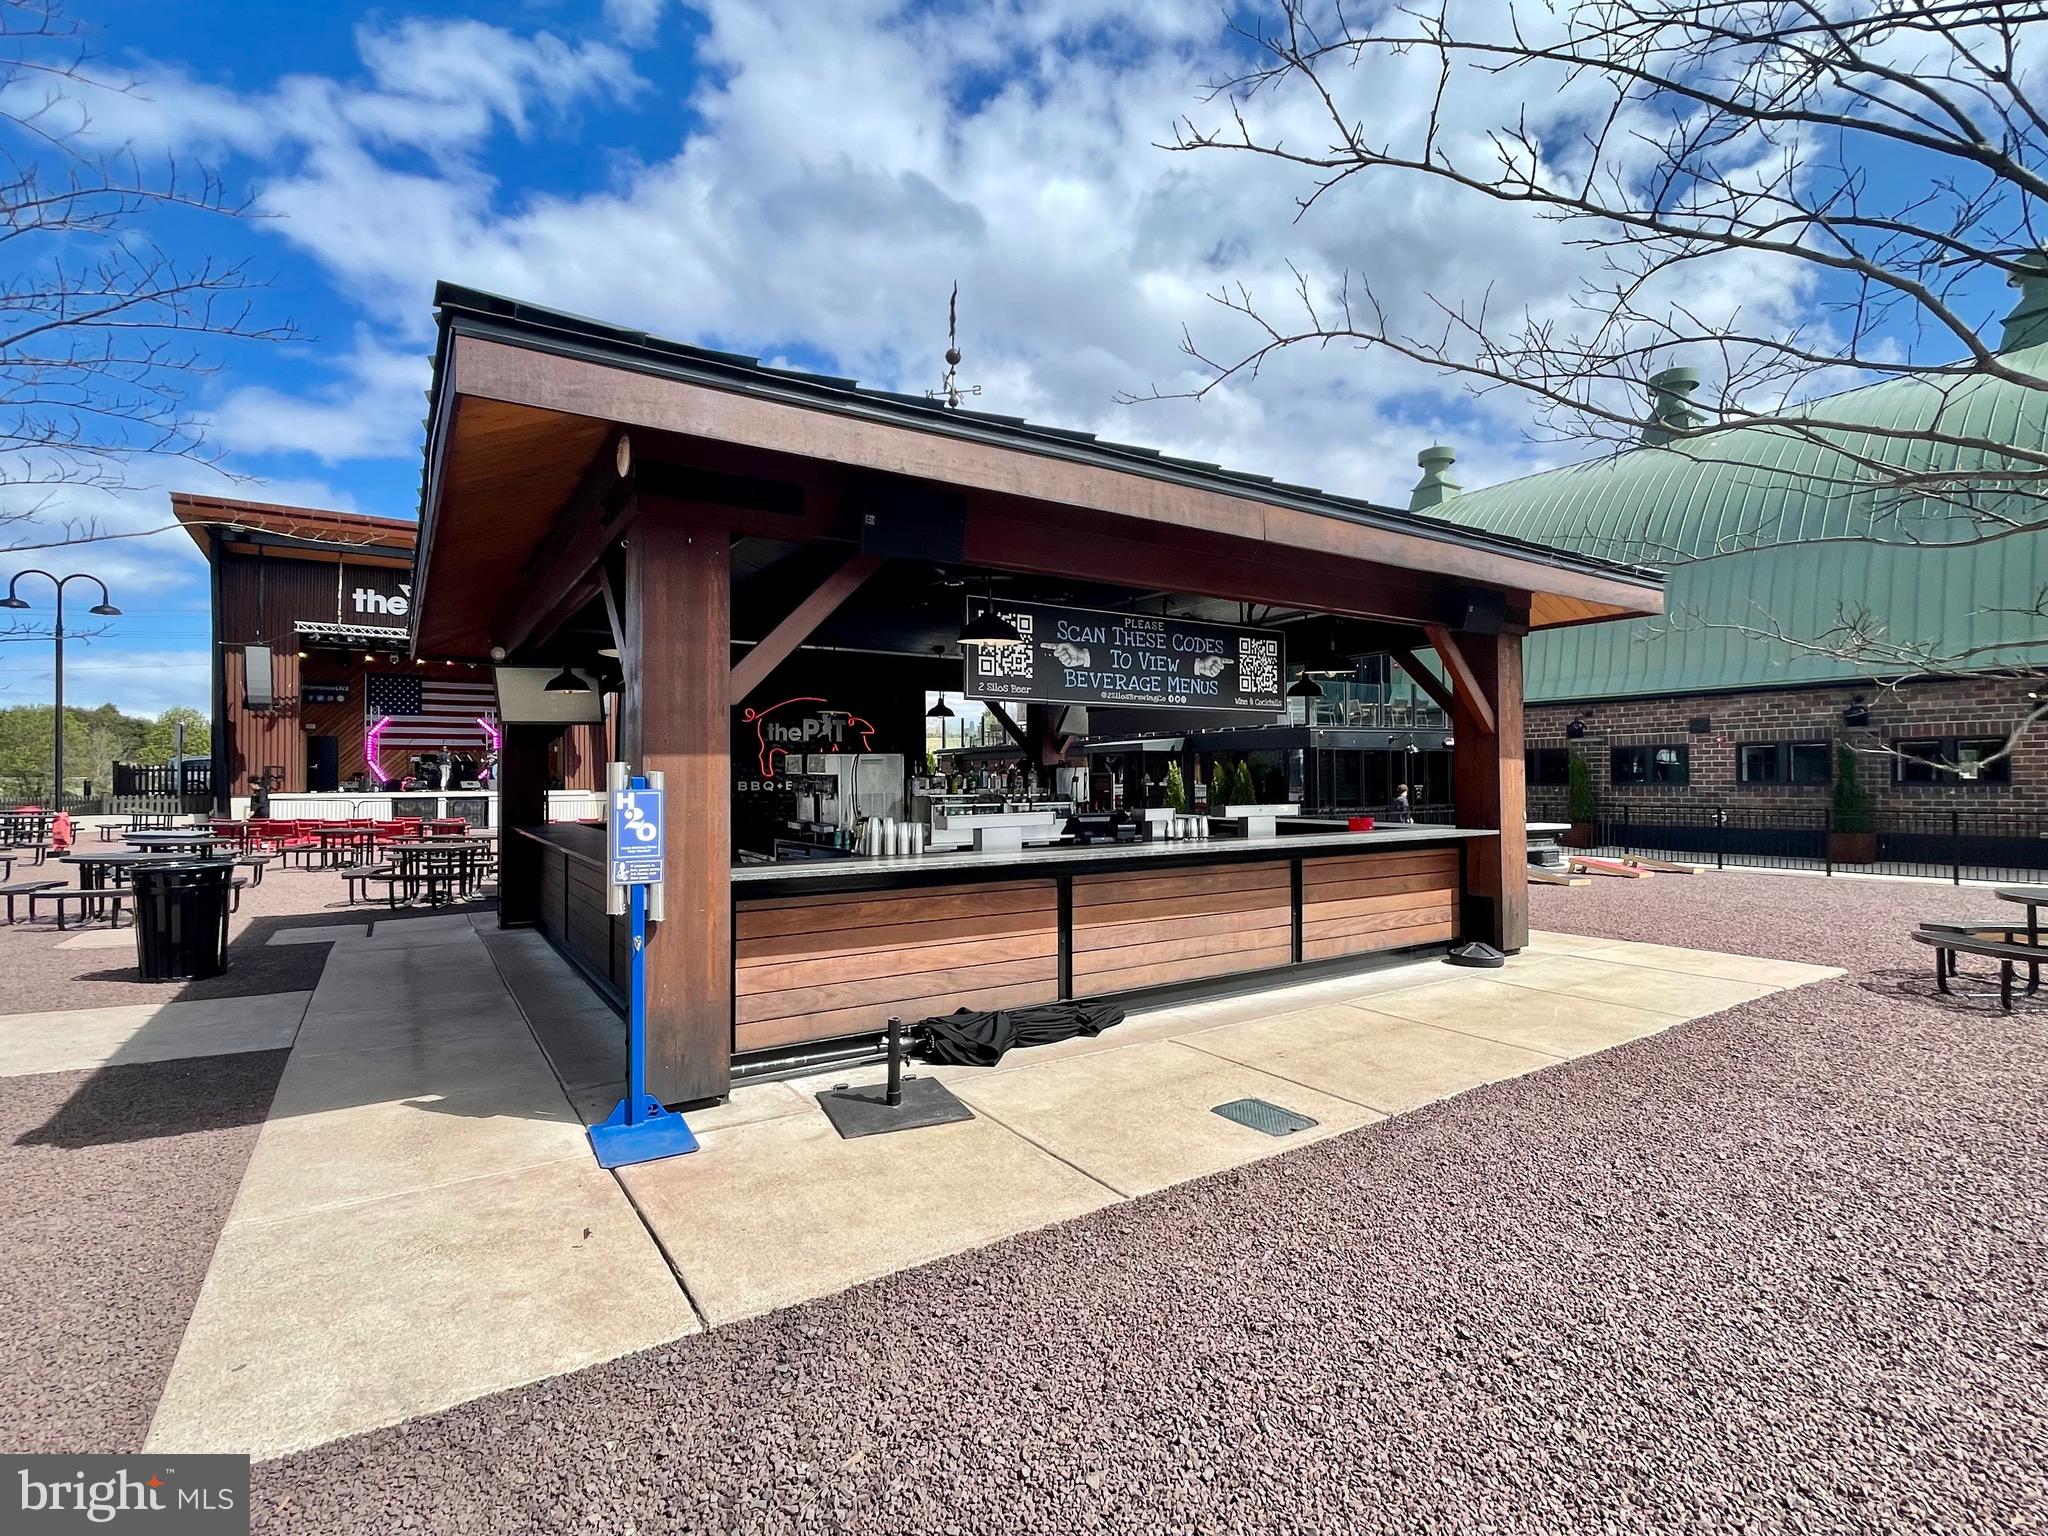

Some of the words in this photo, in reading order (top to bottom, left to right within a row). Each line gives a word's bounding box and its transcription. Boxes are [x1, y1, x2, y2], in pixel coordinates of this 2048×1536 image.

[352, 584, 411, 616] the
[1124, 617, 1165, 631] PLEASE
[1056, 620, 1105, 644] SCAN
[1112, 626, 1167, 649] THESE
[1172, 633, 1224, 654] CODES
[1110, 649, 1132, 669] TO
[1138, 652, 1180, 672] VIEW
[978, 682, 985, 691] 2
[1010, 684, 1032, 694] Beer
[1063, 669, 1161, 692] BEVERAGE
[1167, 676, 1218, 695] MENUS
